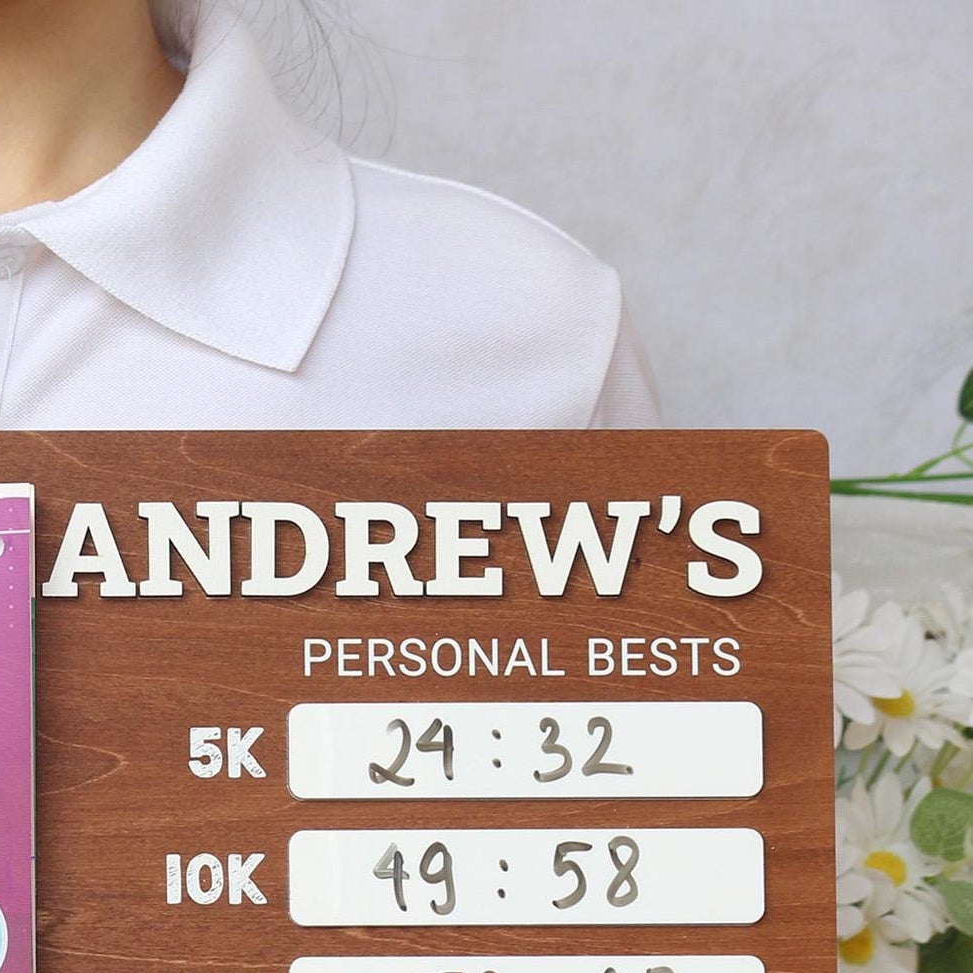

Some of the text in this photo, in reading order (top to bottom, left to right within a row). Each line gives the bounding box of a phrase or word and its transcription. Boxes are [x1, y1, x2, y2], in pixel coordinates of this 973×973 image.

[42, 495, 764, 598] ANDREW'S
[303, 637, 742, 678] PERSONAL BESTS
[188, 726, 266, 780] 5K
[165, 852, 268, 906] 10K
